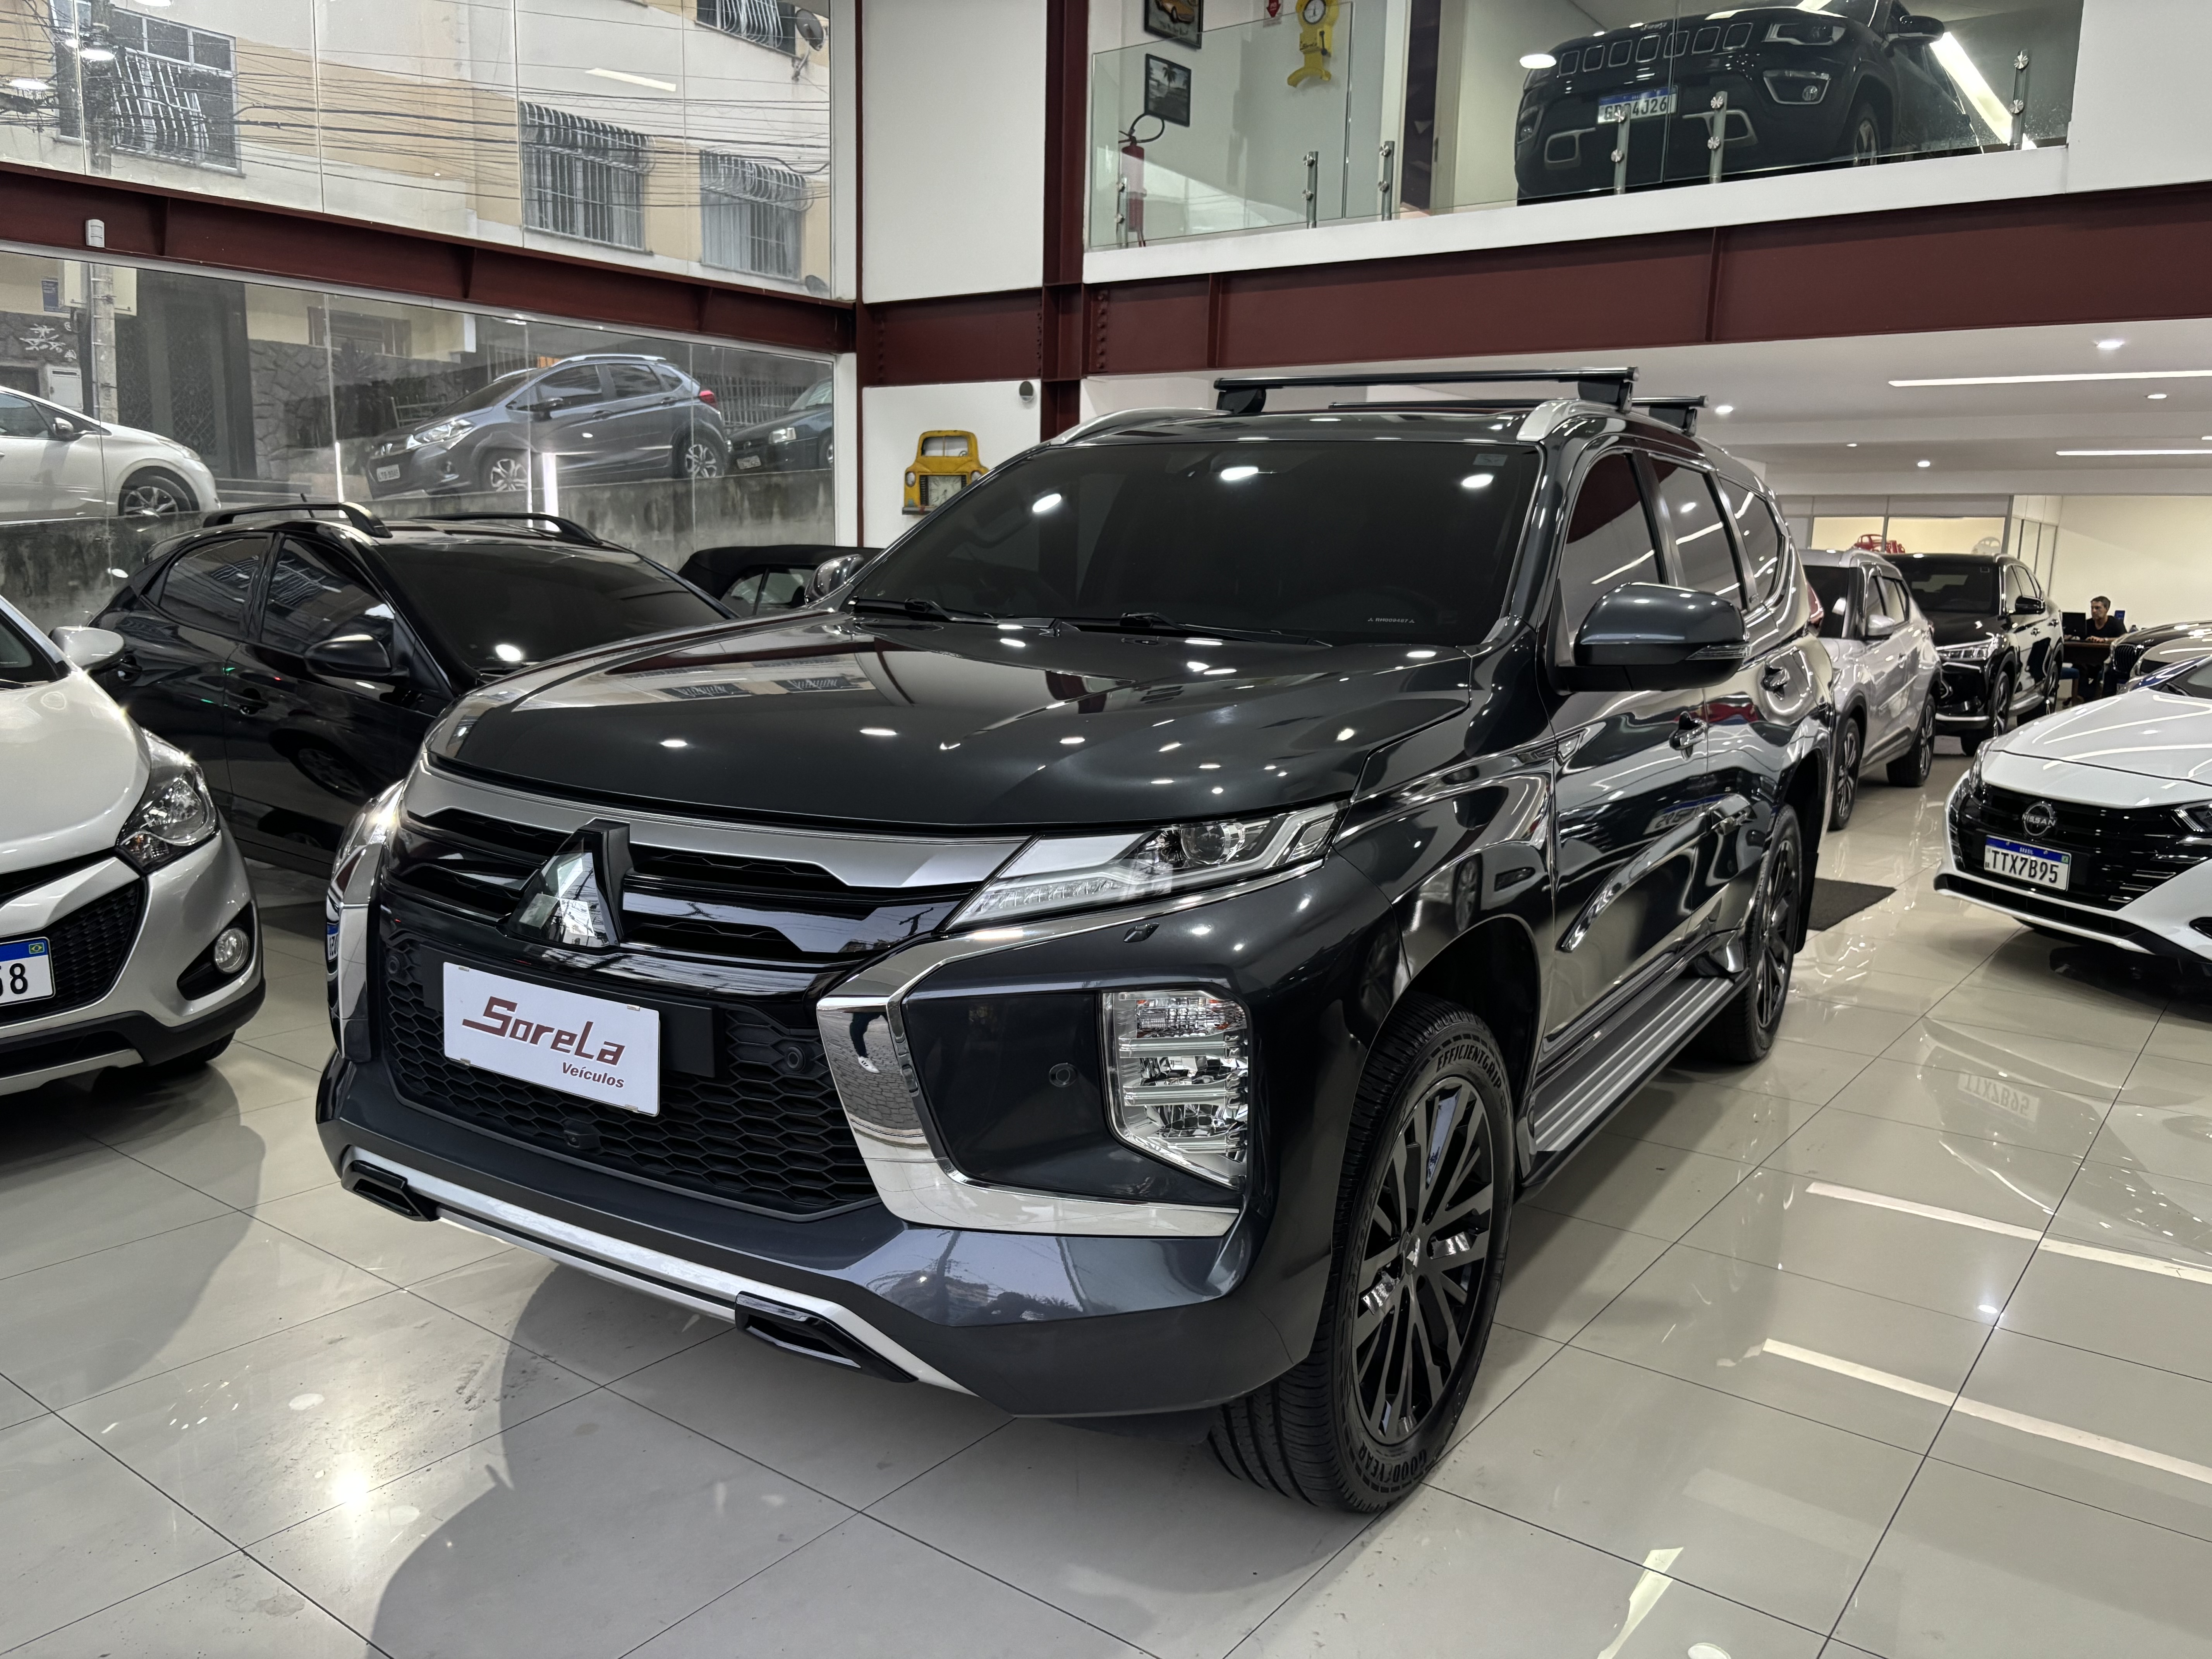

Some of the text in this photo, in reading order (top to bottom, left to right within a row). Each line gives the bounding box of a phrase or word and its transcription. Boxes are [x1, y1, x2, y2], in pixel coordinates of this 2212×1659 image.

[2022, 814, 2056, 826] NISSAN
[1992, 850, 2059, 883] TTX7B95
[0, 963, 28, 995] 8
[563, 1062, 625, 1089] Veículos
[1436, 1044, 1502, 1089] EFFICIENTGRIP
[1358, 1440, 1427, 1483] GOODYEAR
